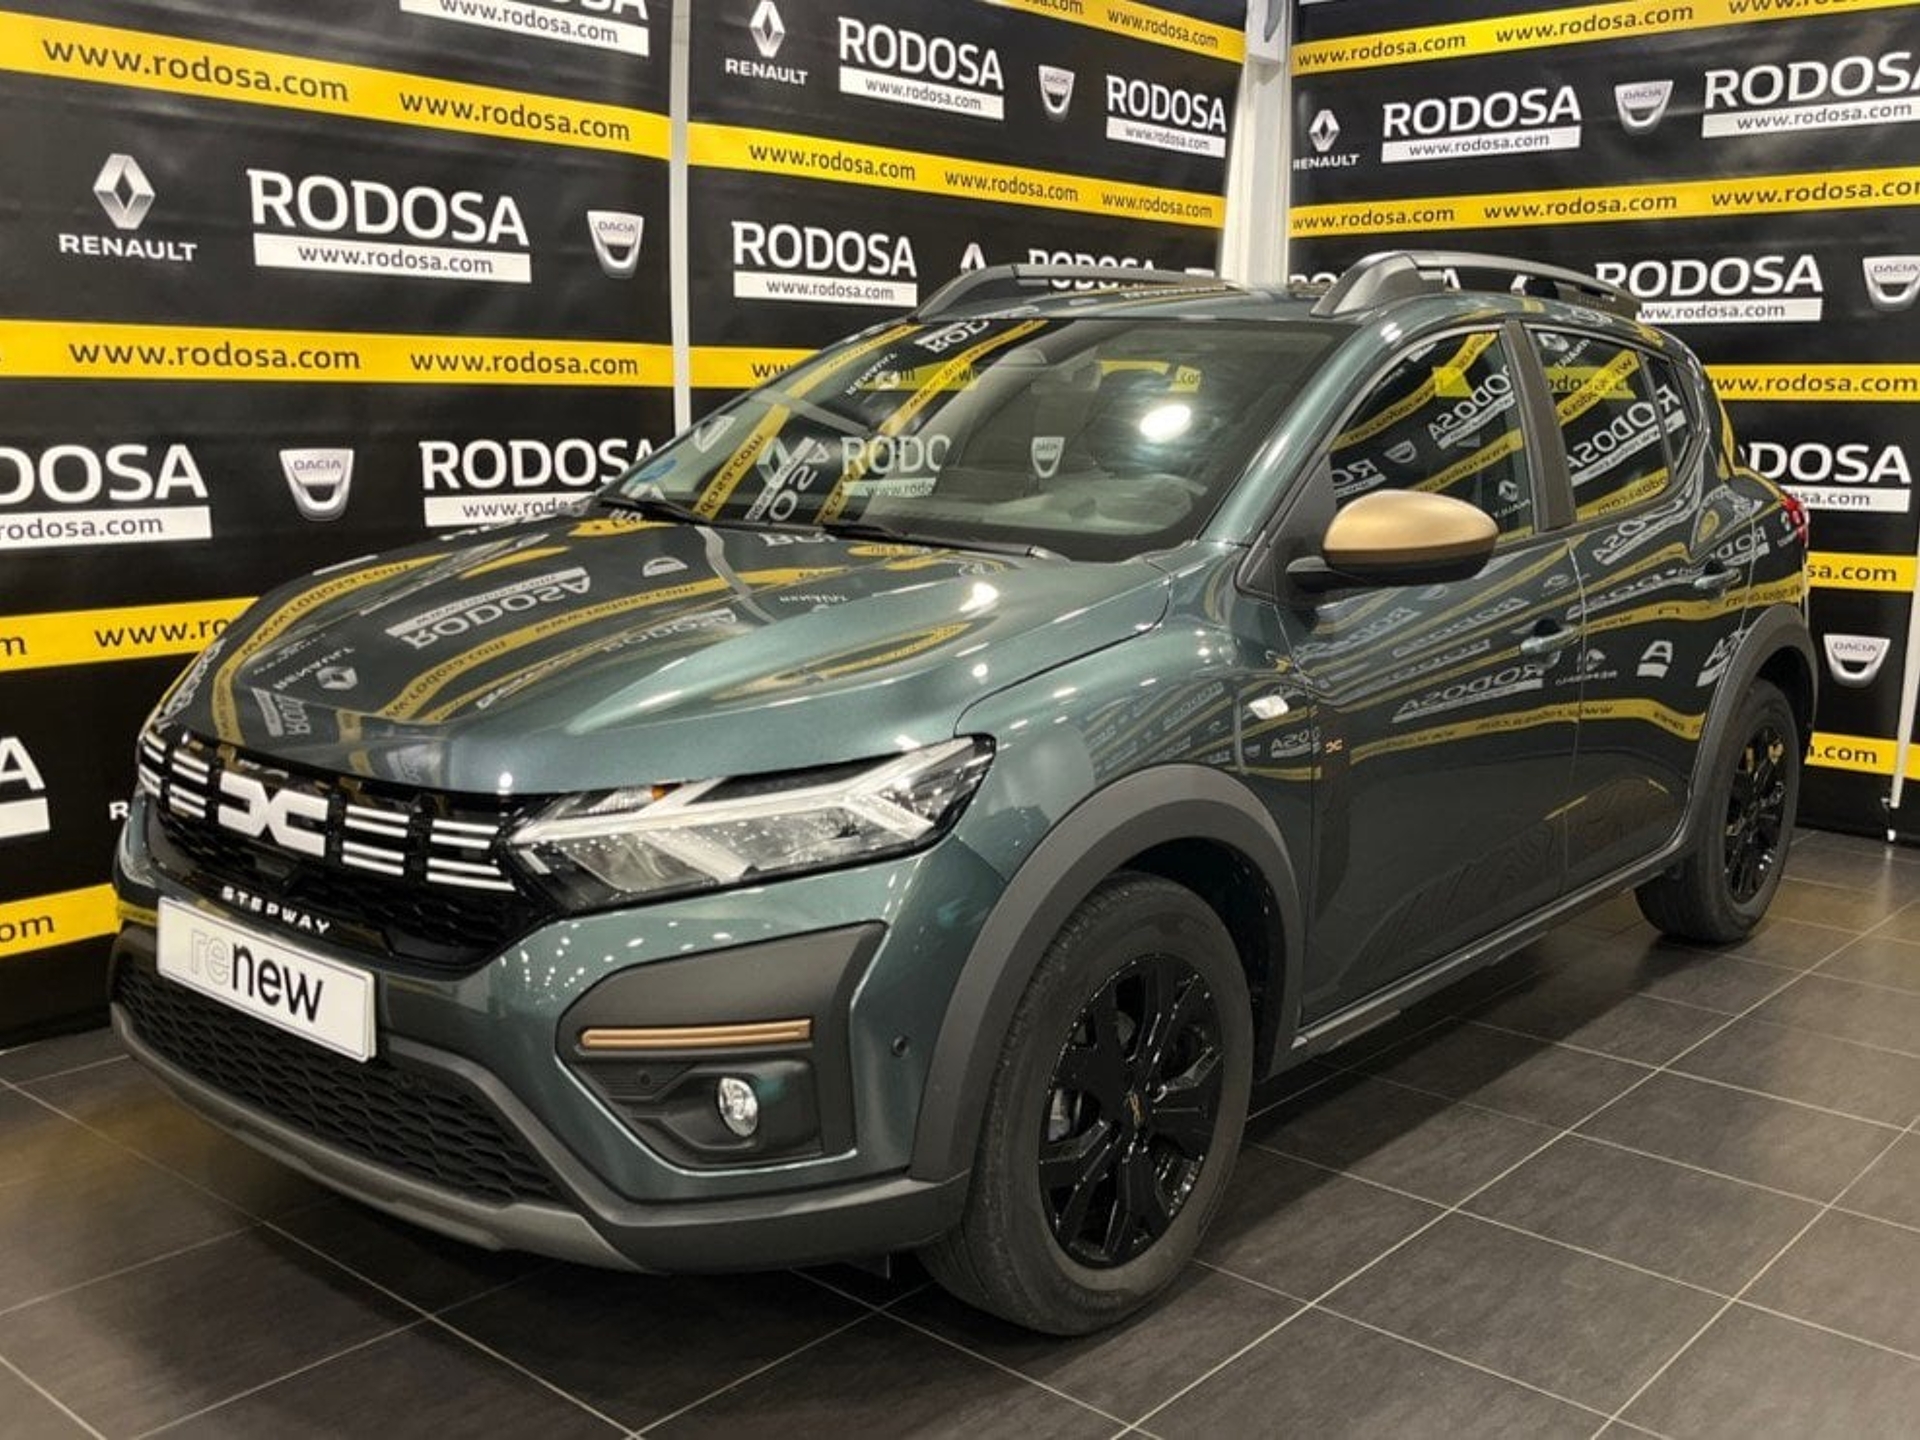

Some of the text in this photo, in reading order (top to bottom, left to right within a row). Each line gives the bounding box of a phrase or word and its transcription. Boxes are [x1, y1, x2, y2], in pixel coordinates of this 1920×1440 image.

[1107, 8, 1219, 49] www.rodosa.com
[1496, 3, 1694, 45] www.rodosa.com
[838, 16, 1005, 90] RODOSA
[1298, 34, 1466, 67] www.rodosa.com
[42, 38, 349, 102] www.rodosa.com
[725, 58, 808, 85] RENAULT
[1704, 51, 1920, 109] RODOS
[865, 78, 982, 110] www.rodosa.com
[1105, 75, 1227, 133] RODOSA
[399, 90, 631, 142] www.rodosa.com
[1382, 84, 1582, 138] RODOSA
[1738, 104, 1911, 130] www.rodosa.com
[1126, 127, 1211, 151] www.rodosa.com
[1409, 134, 1550, 157] www.rodosa.com
[748, 143, 916, 182] www.rodosa.com
[944, 169, 1079, 203] www.rodosa.com
[246, 168, 530, 247] RODOSA
[1101, 189, 1213, 219] www.rodosa.com
[1293, 207, 1455, 230] www.rodosa.com
[1483, 192, 1678, 219] www.rodosa.com
[598, 220, 636, 233] DACIA
[58, 234, 198, 262] RENAULT
[296, 245, 494, 274] www.rodosa.com
[731, 220, 918, 279] RODOSA
[1595, 254, 1824, 298] RODOSA
[1874, 263, 1919, 273] DACIA
[766, 277, 895, 301] www.rodosa.com
[69, 338, 361, 371] www.rodosa.com
[409, 348, 638, 377] www.rodosa.com
[293, 459, 341, 471] DACIA
[1833, 641, 1877, 653] DACIA
[221, 885, 331, 934] STEPWAY
